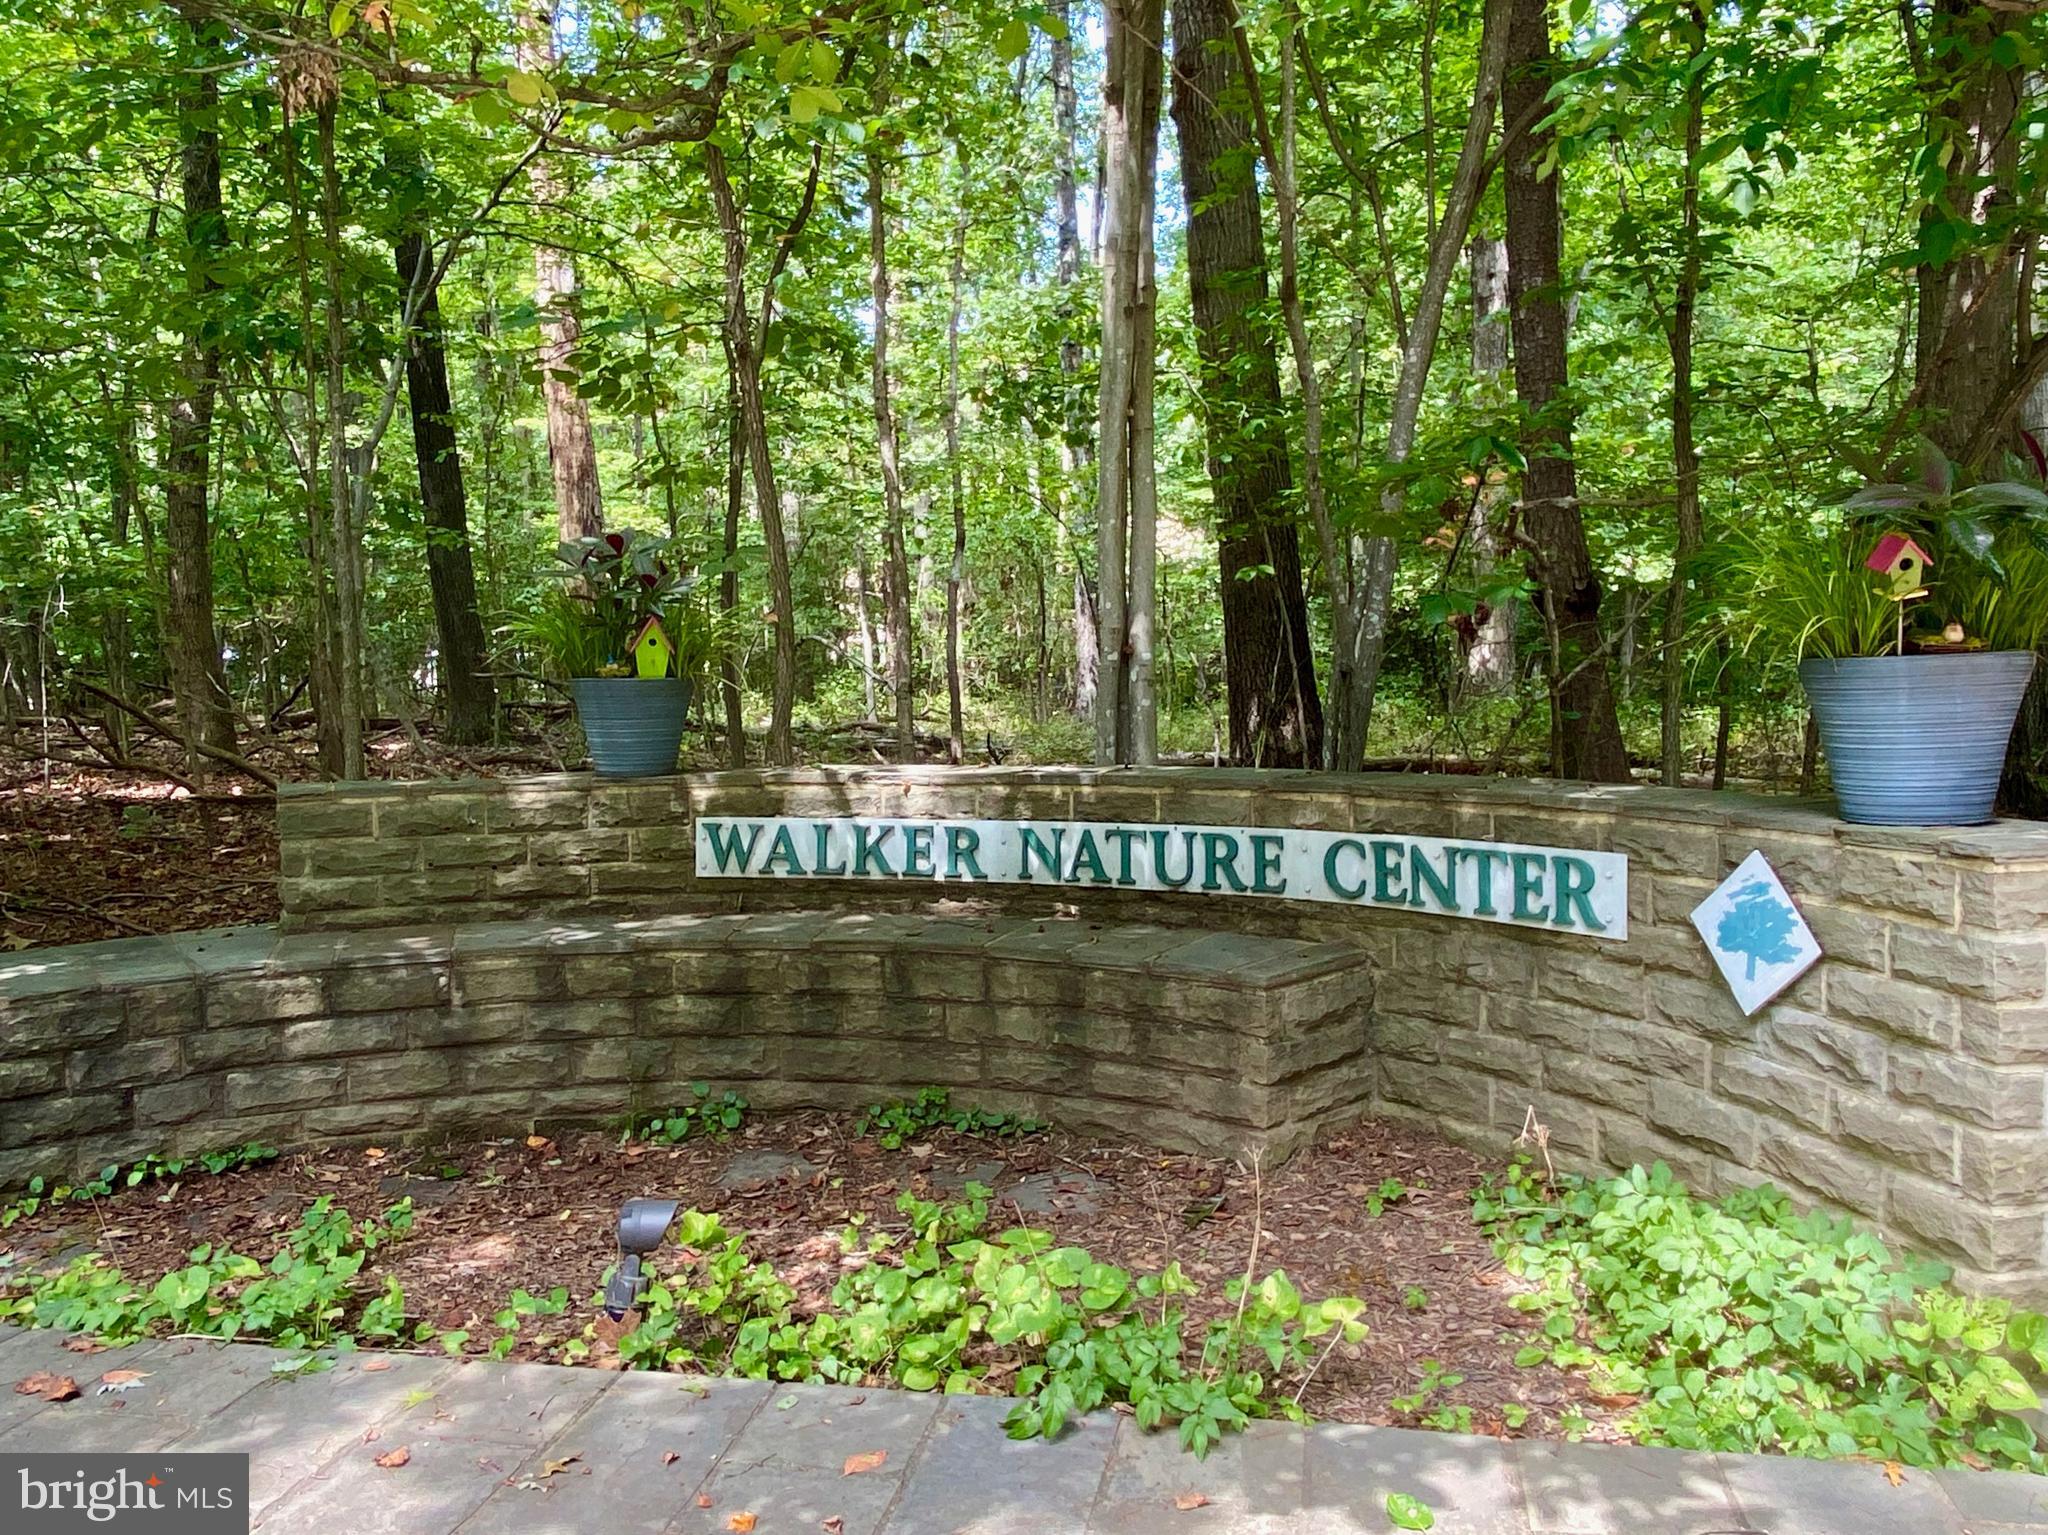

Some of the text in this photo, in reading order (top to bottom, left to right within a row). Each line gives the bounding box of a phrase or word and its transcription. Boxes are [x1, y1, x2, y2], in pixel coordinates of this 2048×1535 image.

[701, 822, 1607, 931] WALKER NATURE CENTER
